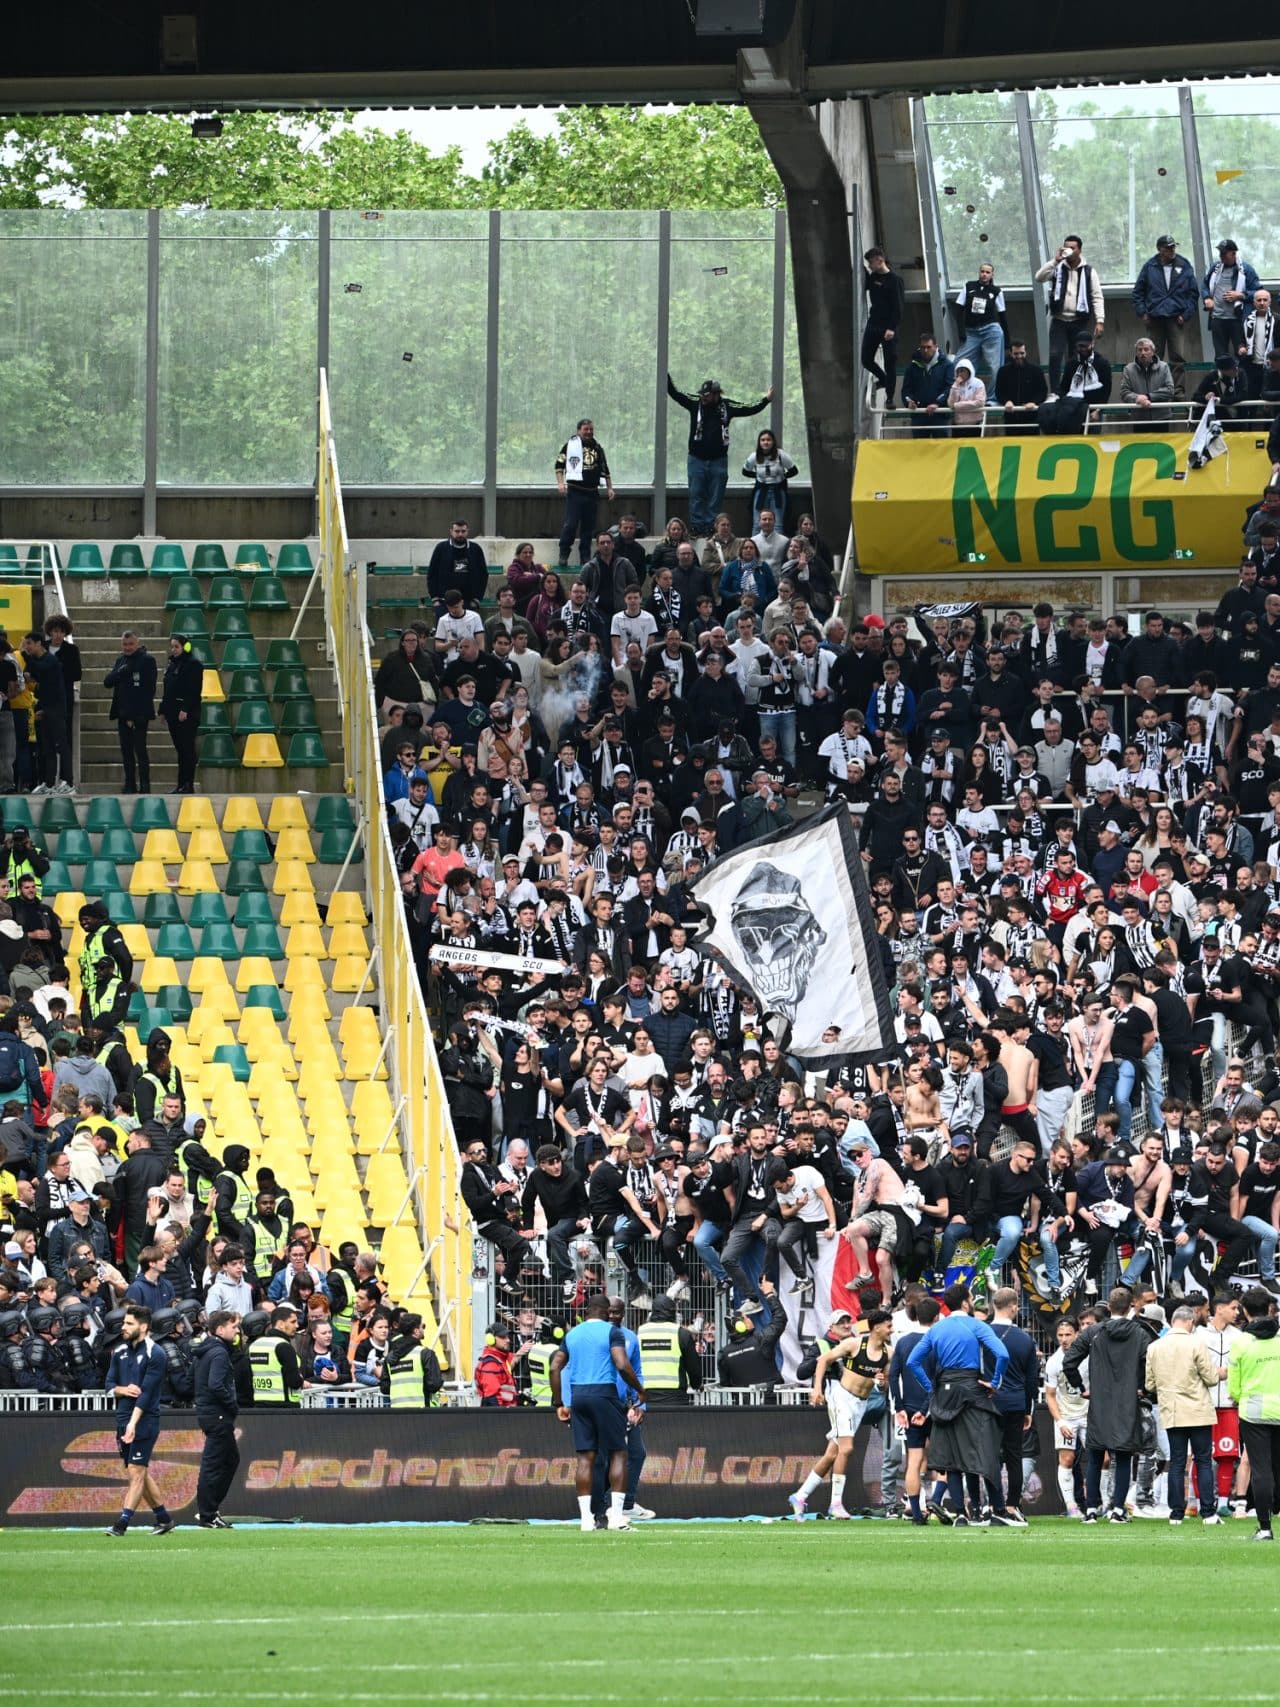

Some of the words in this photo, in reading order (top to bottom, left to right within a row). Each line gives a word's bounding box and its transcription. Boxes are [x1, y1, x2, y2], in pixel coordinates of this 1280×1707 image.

[952, 442, 1178, 563] N2G
[1240, 770, 1265, 782] SCO
[439, 949, 478, 963] ANGERS
[521, 960, 544, 970] SCO
